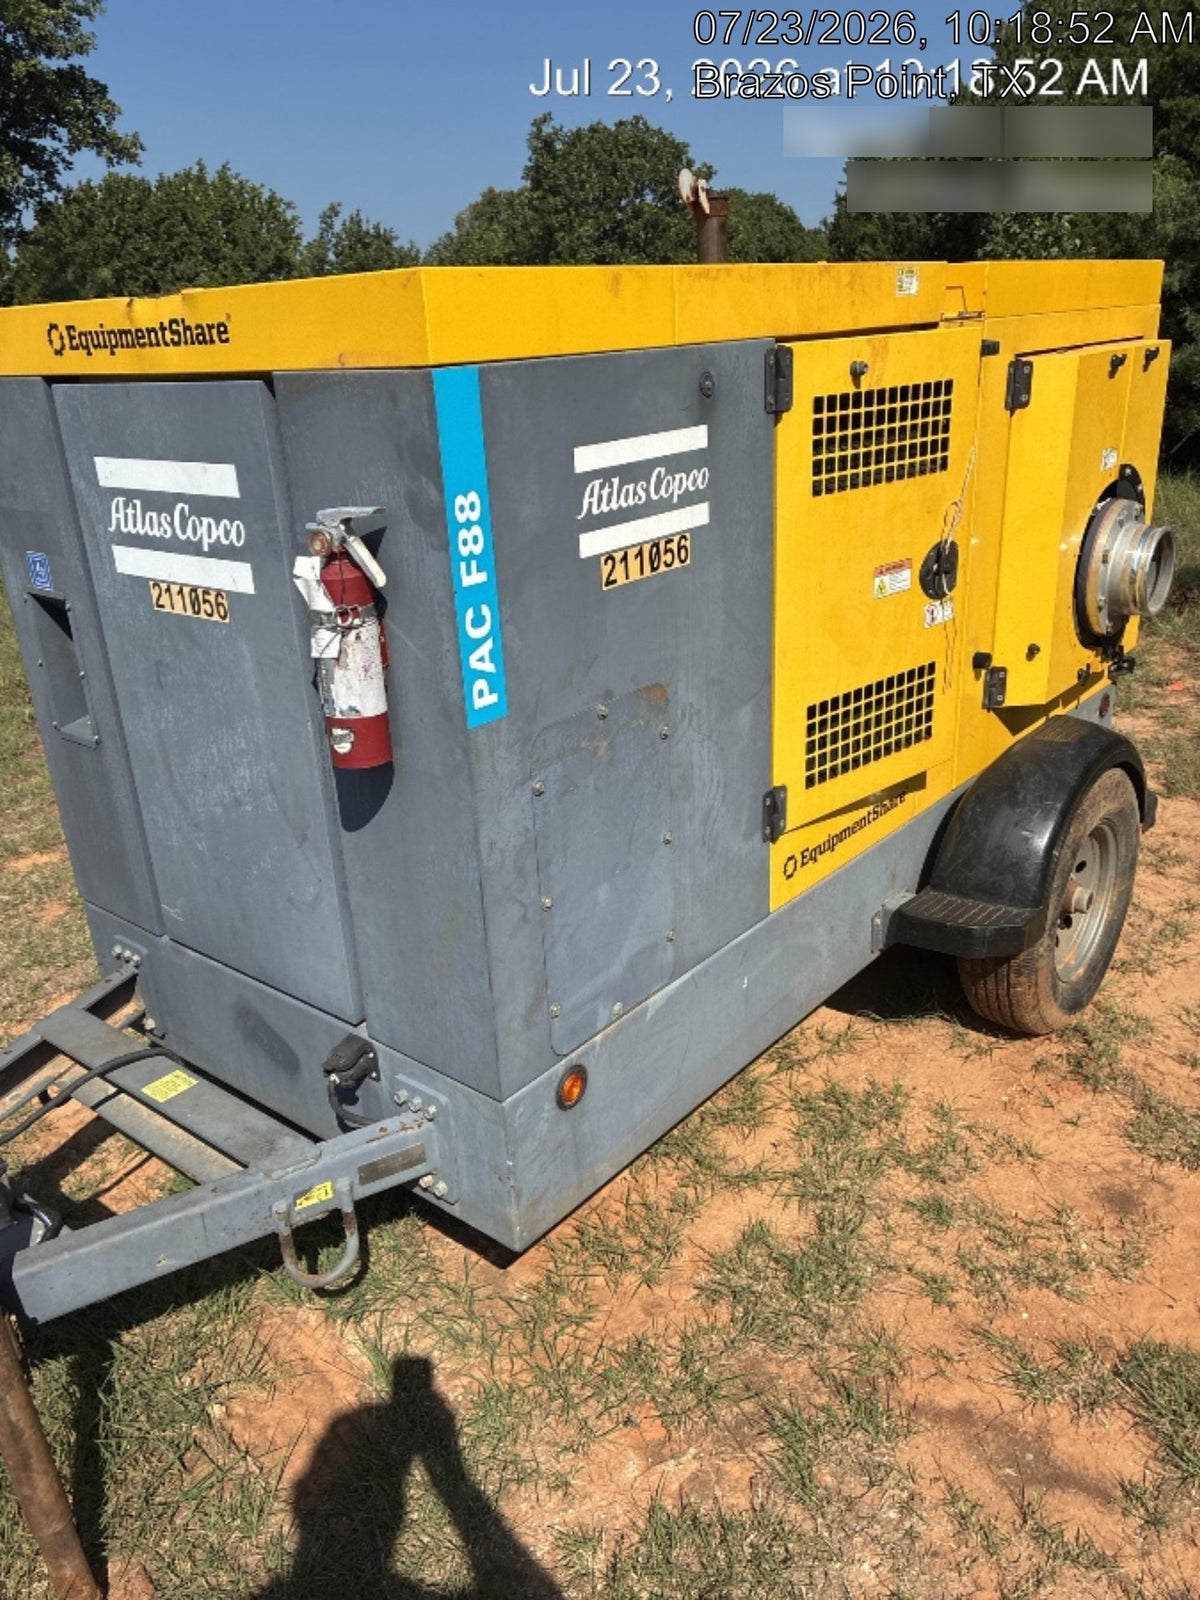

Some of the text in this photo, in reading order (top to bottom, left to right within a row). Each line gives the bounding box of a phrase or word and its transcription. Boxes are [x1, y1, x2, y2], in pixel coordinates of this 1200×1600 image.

[65, 318, 230, 355] EquipmentShare
[577, 466, 710, 520] Atlas Copco
[108, 496, 245, 551] Atlas Copco
[602, 534, 689, 587] 211056
[152, 582, 229, 621] 211056
[455, 490, 499, 710] PAC F88
[800, 790, 907, 868] EquipmentShare
